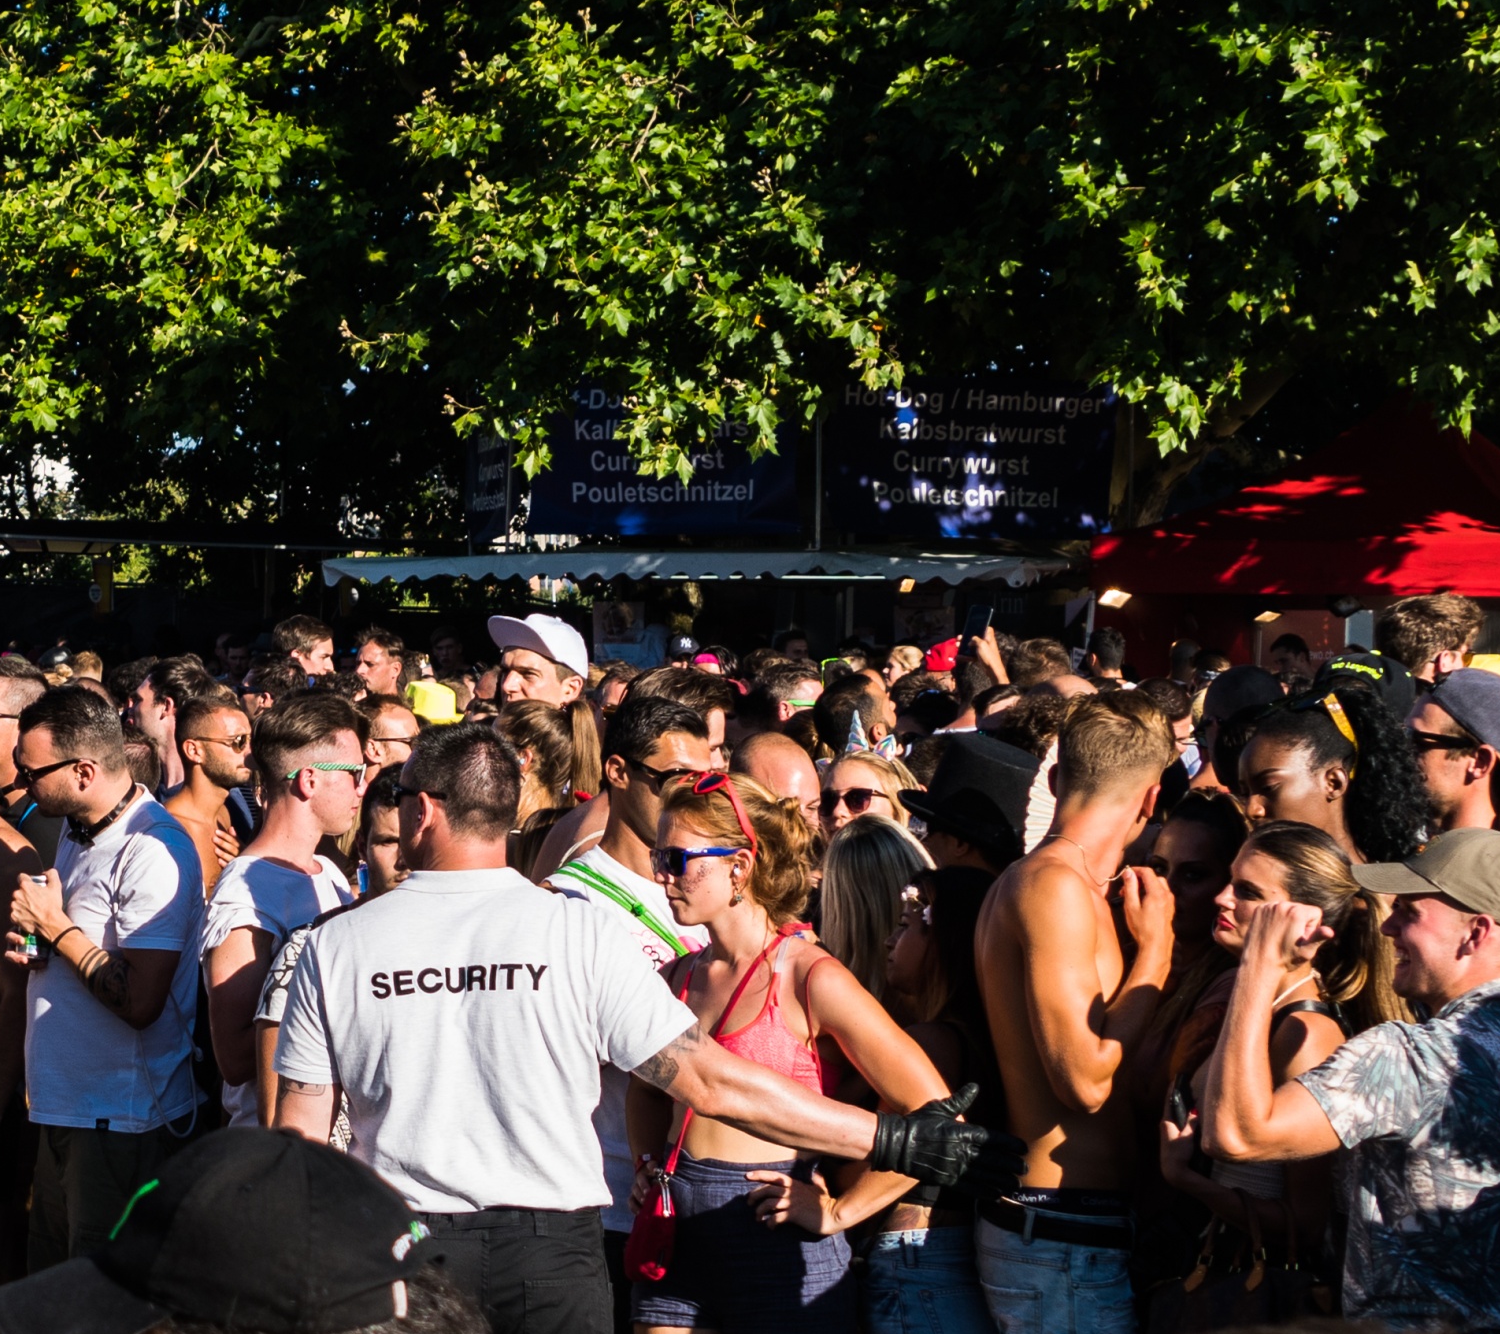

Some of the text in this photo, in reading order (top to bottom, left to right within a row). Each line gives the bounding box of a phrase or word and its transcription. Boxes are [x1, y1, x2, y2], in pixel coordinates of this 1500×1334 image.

[844, 384, 944, 414] Hot-Dog
[967, 388, 1106, 419] Hamburger
[879, 417, 1067, 446] Kalbsbratwurst
[892, 450, 1030, 479] Currywurst
[572, 479, 754, 504] Pouletschnitzel
[872, 480, 1058, 509] Pouletschnitzel
[369, 960, 549, 1001] SECURITY
